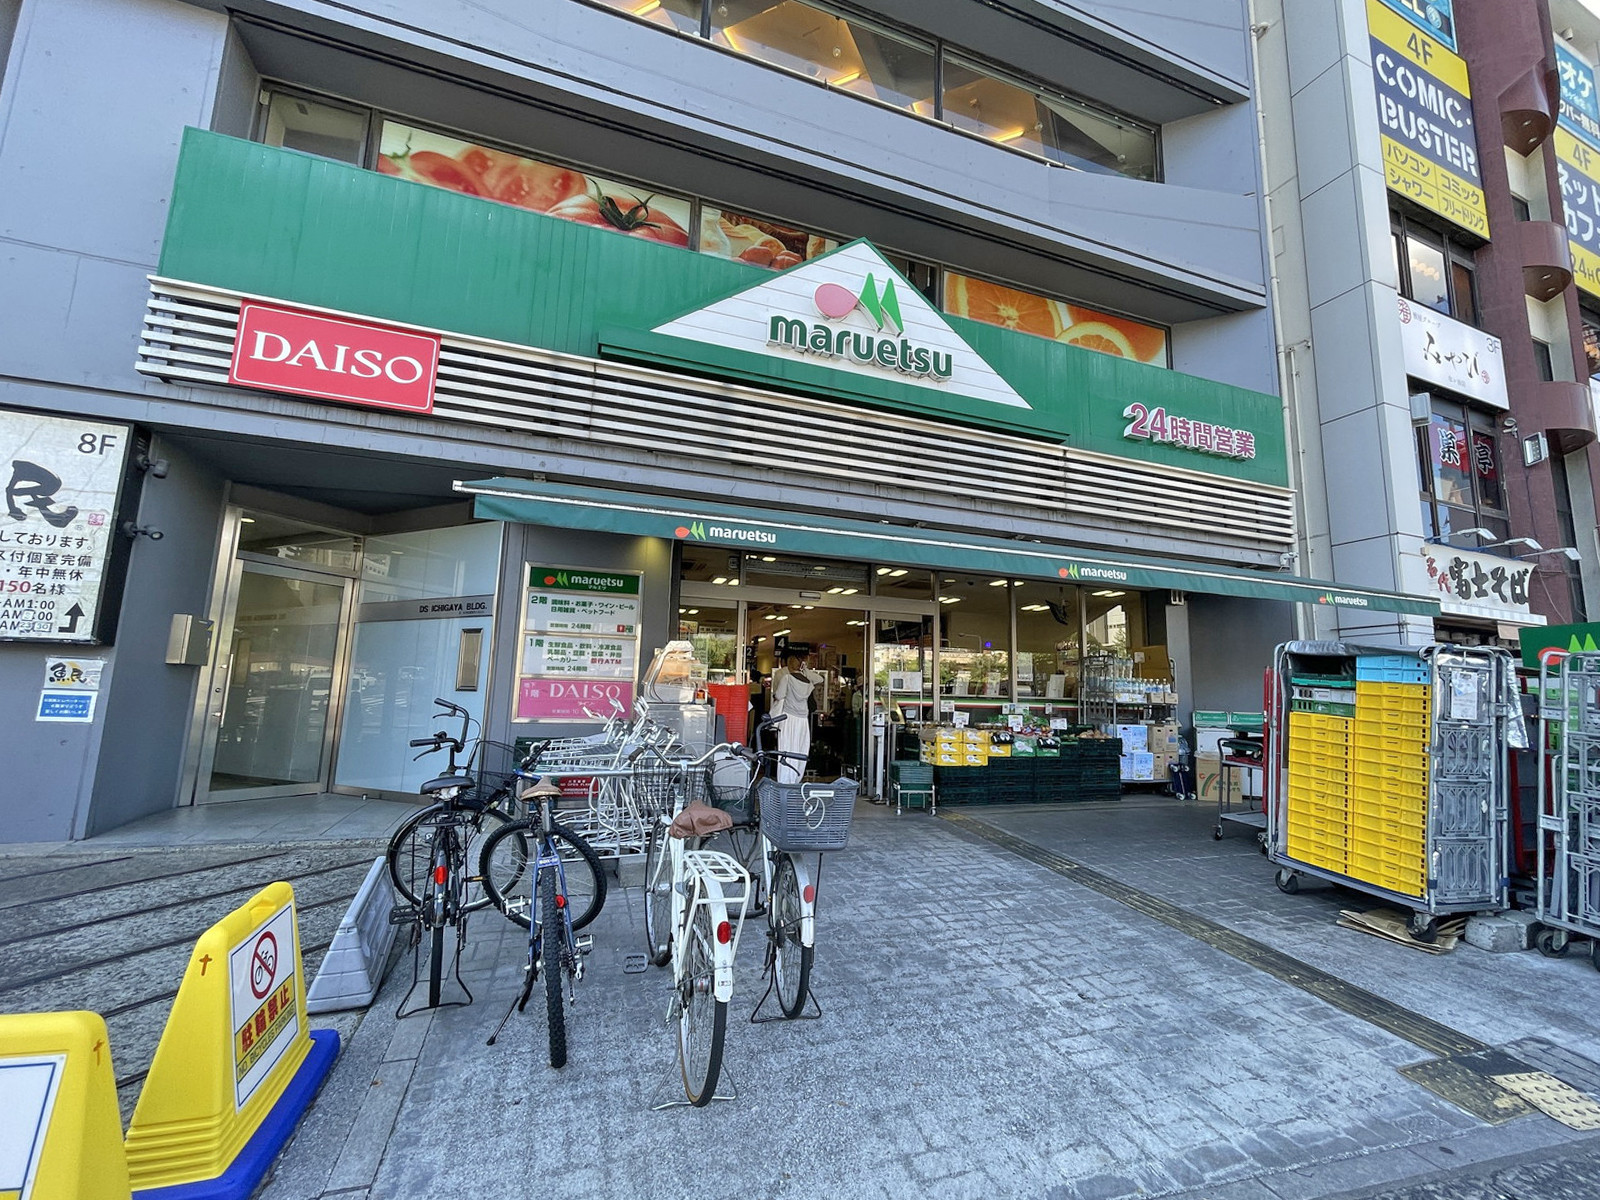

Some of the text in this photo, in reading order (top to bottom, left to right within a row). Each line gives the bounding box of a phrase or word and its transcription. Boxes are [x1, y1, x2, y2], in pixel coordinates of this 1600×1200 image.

[1407, 32, 1433, 65] 4F
[1379, 92, 1478, 177] BUSTER
[1573, 144, 1591, 171] 4F
[1387, 143, 1480, 205] パソコン コミック
[1389, 168, 1485, 231] シャワー フリードリンク
[769, 314, 953, 378] maruetsu
[1486, 337, 1501, 353] 3F
[249, 329, 423, 384] DAISO
[1123, 402, 1256, 460] 24時間営業
[77, 432, 118, 455] 8F
[709, 526, 777, 544] maruetsu
[571, 575, 624, 587] maruetsu
[1080, 567, 1127, 581] maruetsu
[1449, 556, 1530, 605] 富士そば
[431, 603, 463, 612] ICHIGAYA
[530, 595, 548, 605] 2階
[1334, 595, 1368, 606] maruetsu
[529, 638, 544, 647] 1階
[778, 638, 785, 648] 4
[549, 683, 621, 699] DAISO
[241, 984, 290, 1053] 駐輪禁止
[238, 1061, 248, 1077] NO
